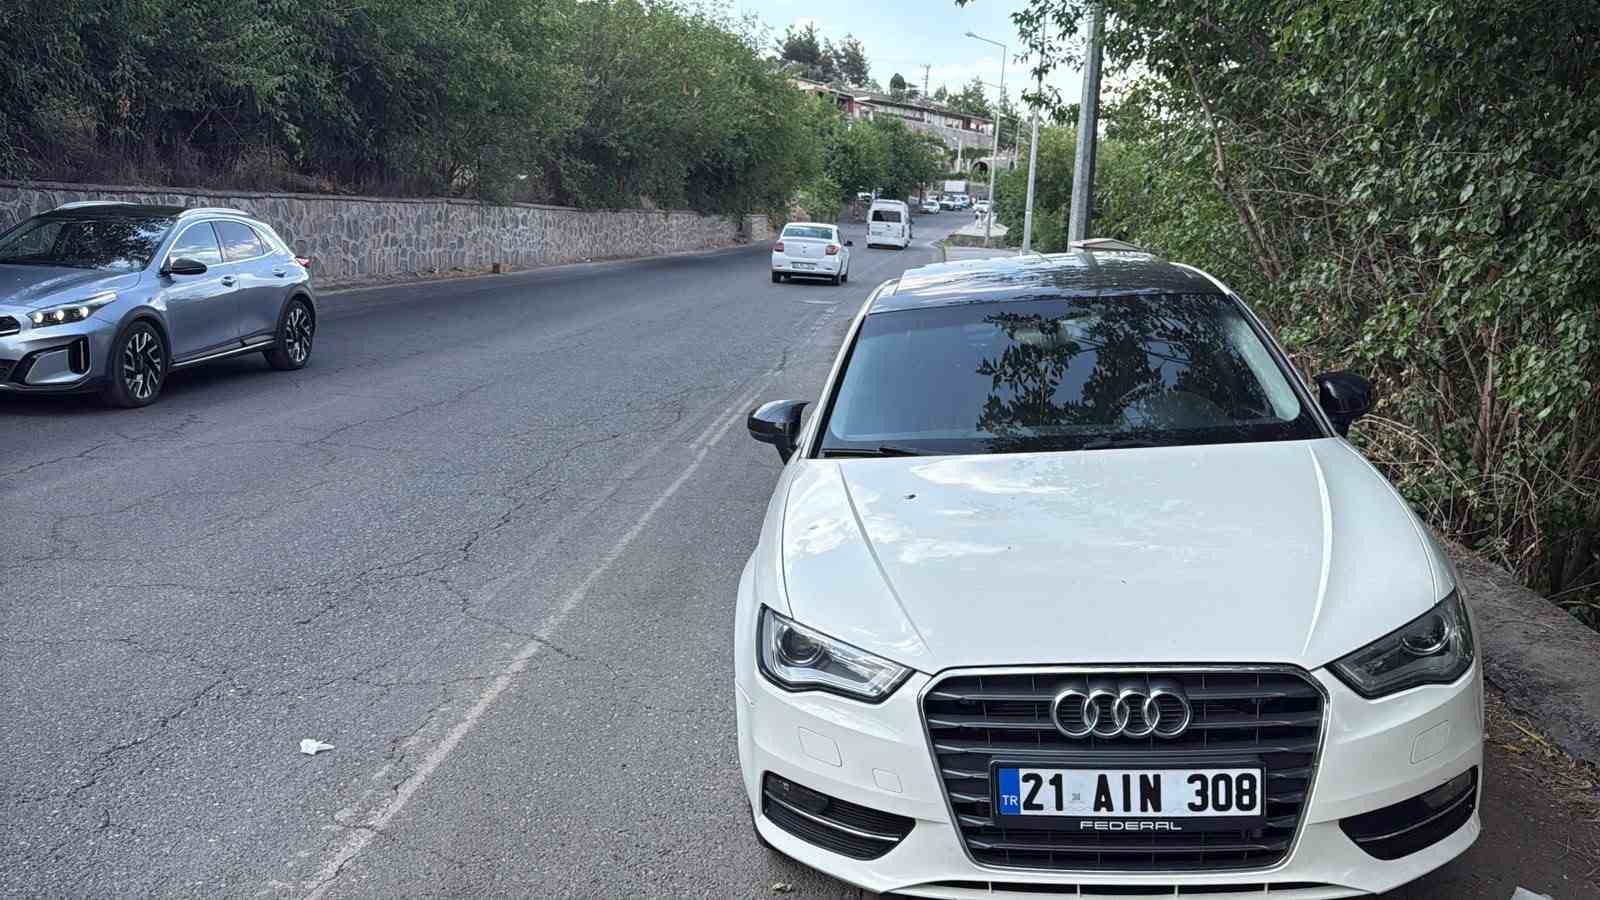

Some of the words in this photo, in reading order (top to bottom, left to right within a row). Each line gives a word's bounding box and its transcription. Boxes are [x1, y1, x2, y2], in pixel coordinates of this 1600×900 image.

[1022, 773, 1064, 811] 21
[1093, 773, 1162, 812] AIN
[1187, 773, 1257, 812] 308
[1001, 795, 1018, 805] TR
[1080, 820, 1182, 831] FEDERAL
